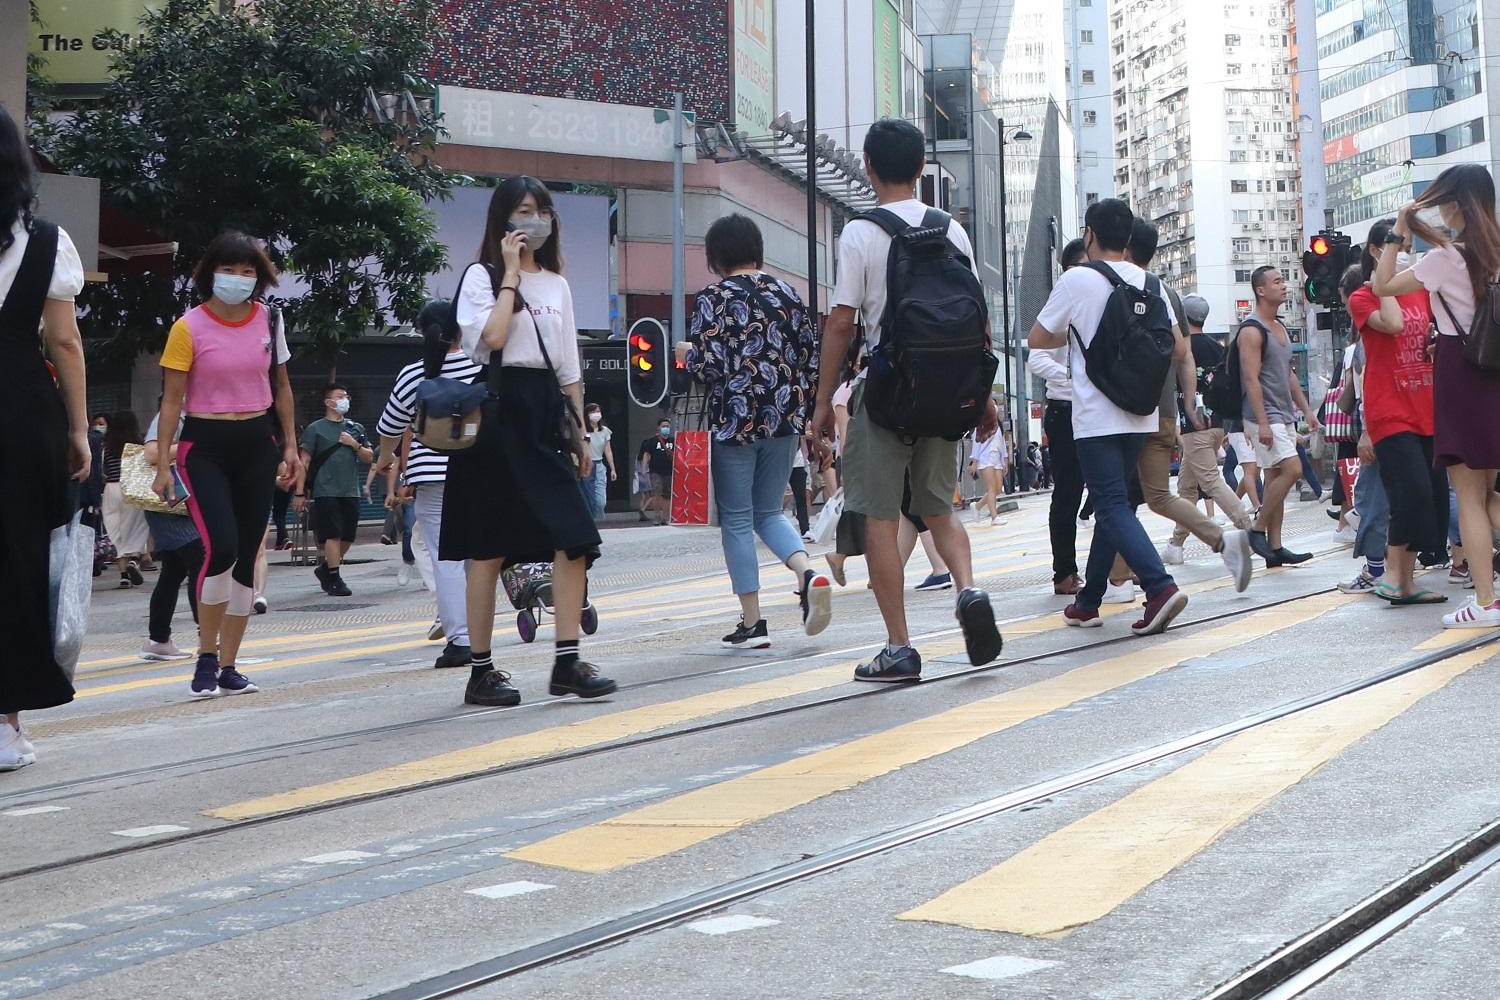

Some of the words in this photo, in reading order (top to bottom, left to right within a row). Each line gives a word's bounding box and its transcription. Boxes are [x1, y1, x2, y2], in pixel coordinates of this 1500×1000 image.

[38, 34, 83, 51] The
[736, 48, 750, 78] FOR
[749, 58, 769, 93] LEASE
[528, 108, 599, 141] 2523
[737, 93, 753, 121] 2523
[753, 105, 768, 132] 1840
